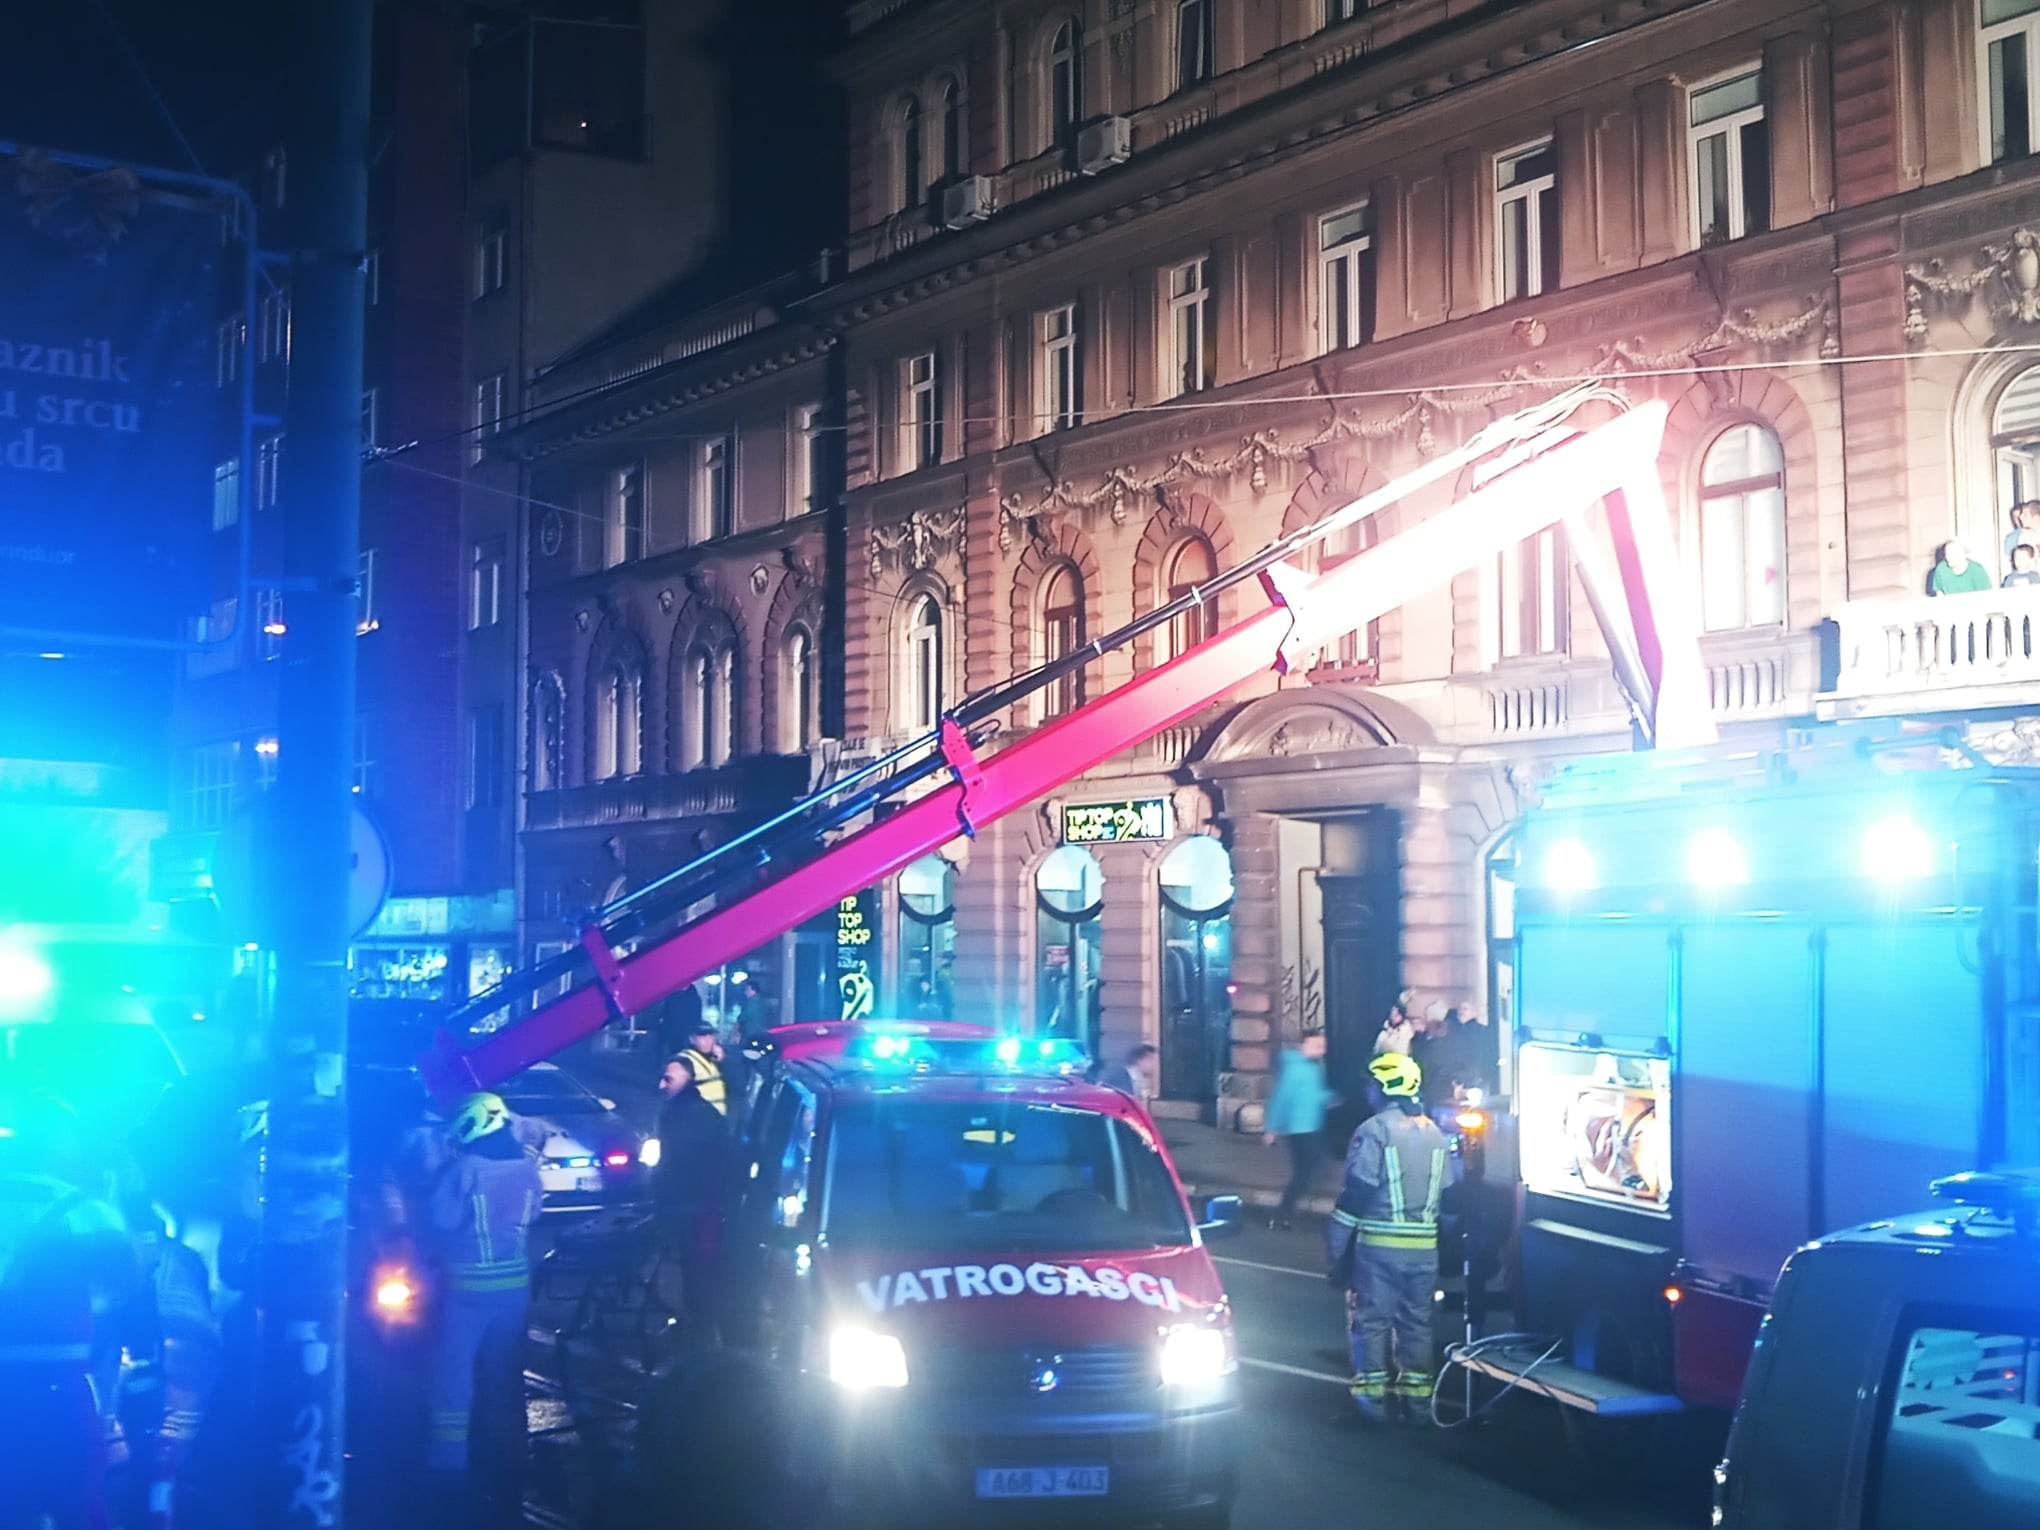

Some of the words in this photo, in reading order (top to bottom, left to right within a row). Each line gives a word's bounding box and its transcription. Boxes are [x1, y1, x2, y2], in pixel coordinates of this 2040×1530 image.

[36, 394, 141, 433] srcu
[0, 427, 66, 473] da
[1086, 807, 1114, 825] TOP
[1067, 825, 1103, 842] SHOP
[838, 912, 863, 928] TOP
[837, 928, 871, 945] SHOP
